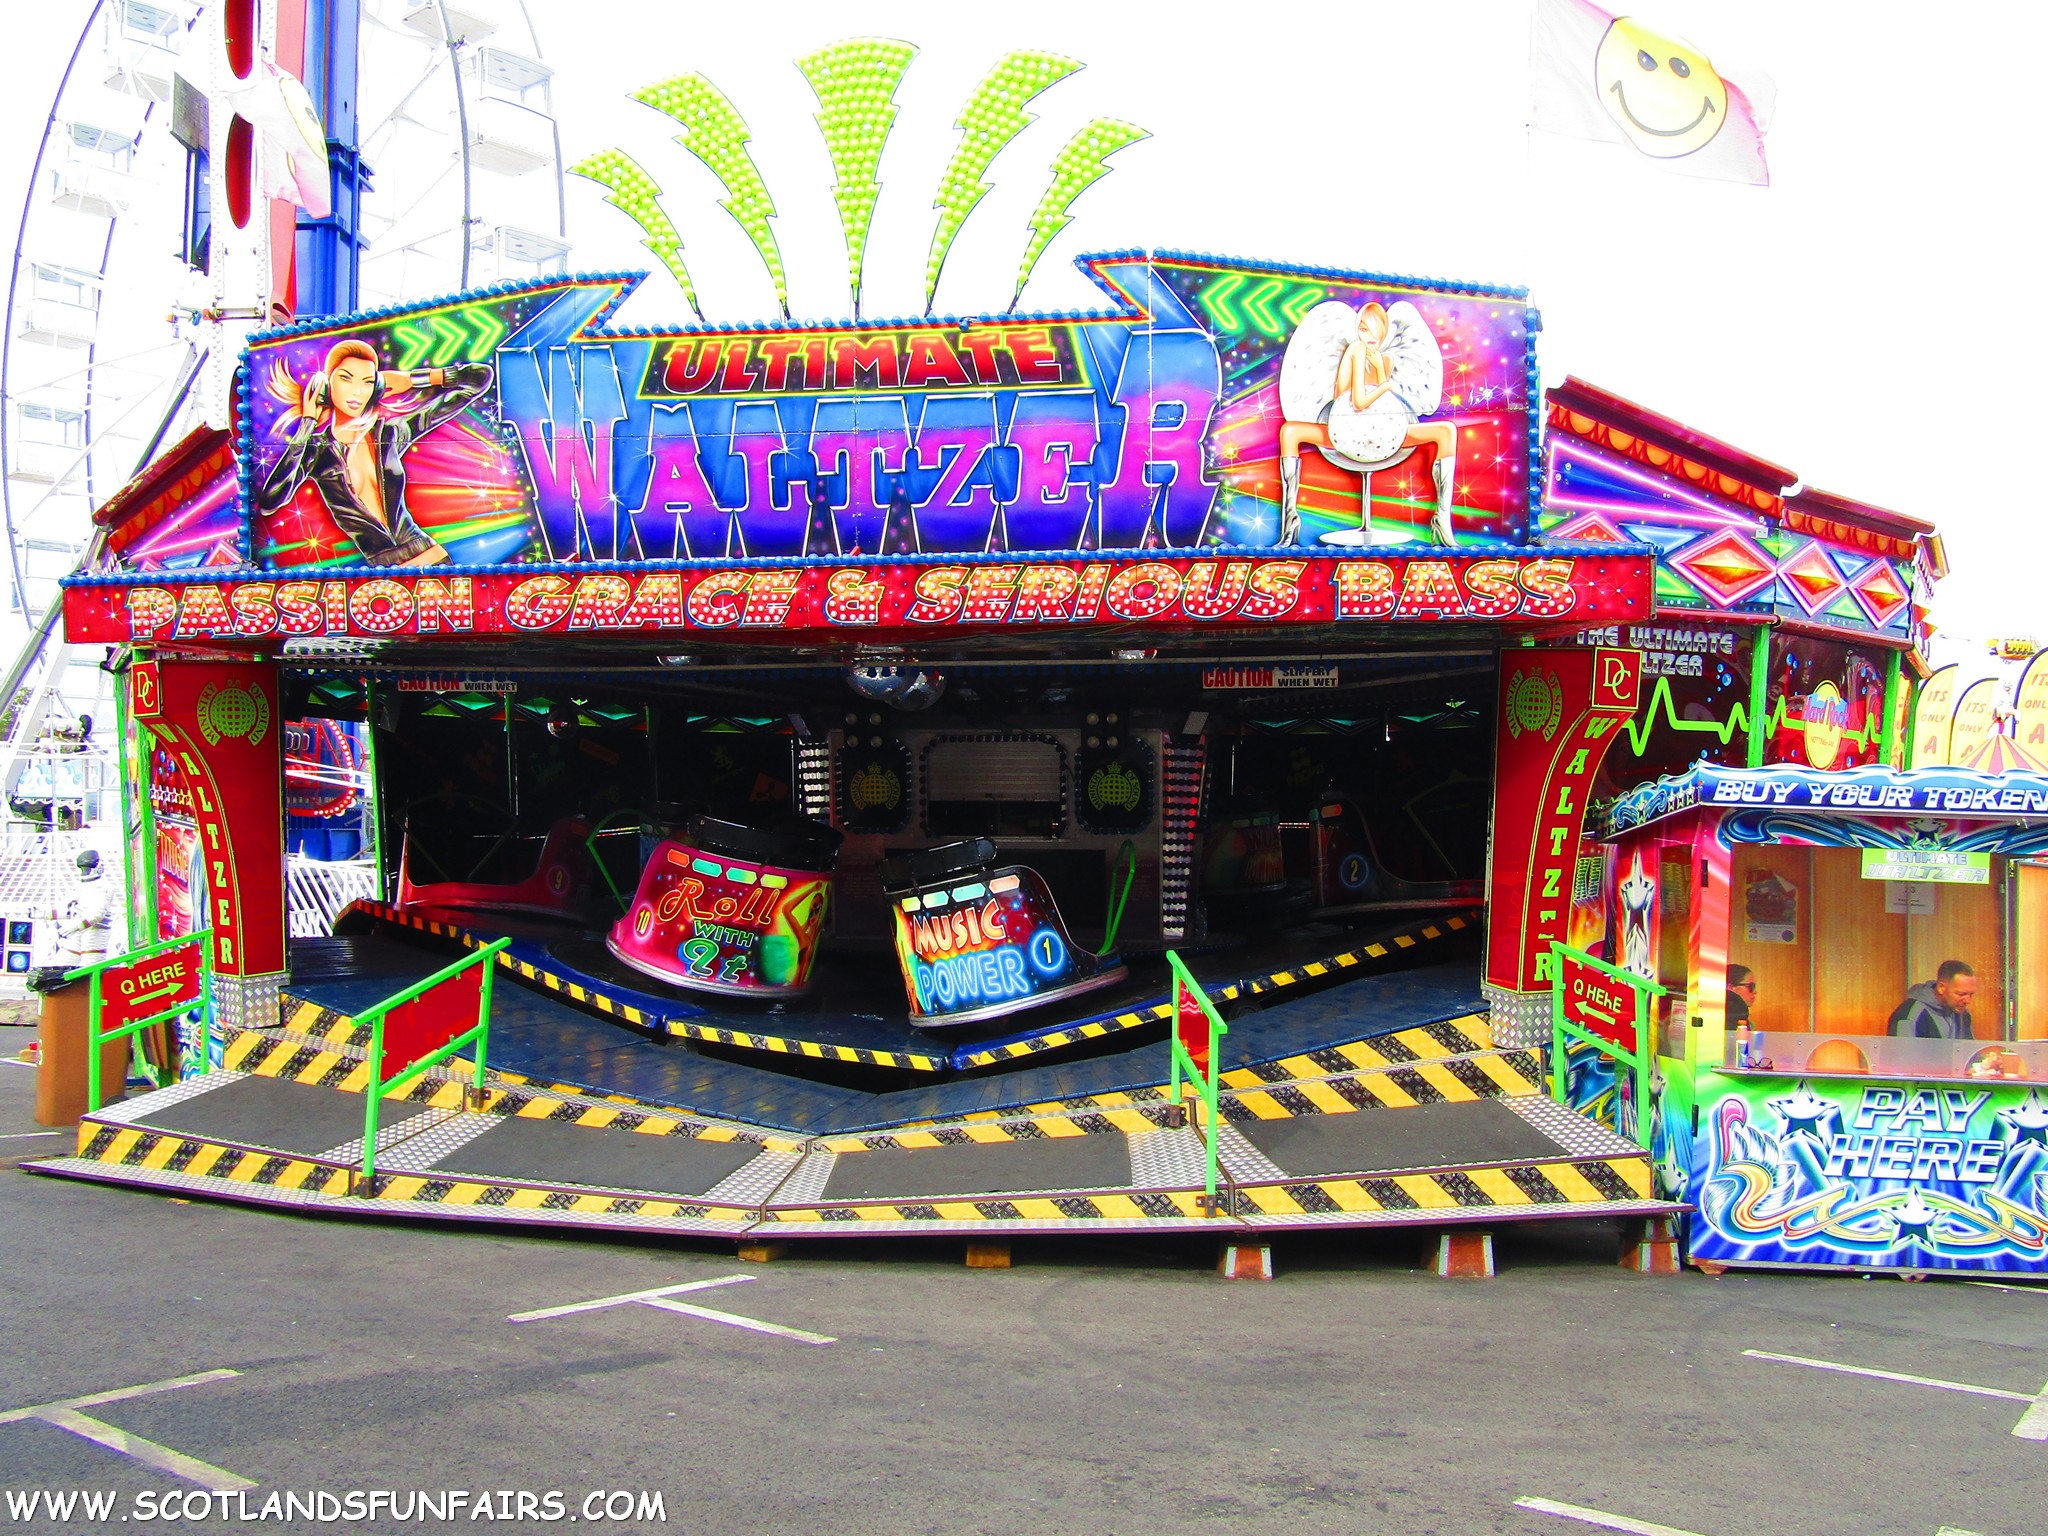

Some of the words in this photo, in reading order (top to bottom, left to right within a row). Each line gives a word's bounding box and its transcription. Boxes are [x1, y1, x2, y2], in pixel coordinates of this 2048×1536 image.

[664, 328, 1062, 394] ULTIMATE
[496, 332, 1223, 559] WALTZER
[125, 578, 474, 640] PASSION
[506, 570, 802, 632] GRACE
[829, 567, 884, 627] &
[905, 561, 1307, 625] SERIOUS
[1334, 559, 1578, 620] BASS
[1577, 626, 1619, 646] THE
[1629, 626, 1733, 655] ULTIMATE
[1203, 668, 1273, 687] CAUTION
[1602, 657, 1632, 700] DC
[1641, 652, 1703, 677] LTZER
[136, 671, 154, 708] DC
[464, 682, 492, 691] WHEN
[495, 682, 516, 691] WET
[1278, 677, 1310, 687] WHEN
[1313, 677, 1337, 687] WET
[2031, 674, 2048, 686] IT
[1506, 670, 1523, 738] MINISTRY
[1545, 695, 1563, 741] SOUND
[1927, 690, 1949, 702] ITS
[198, 682, 219, 745] MINISTRY
[251, 703, 269, 745] SOUND
[1920, 714, 1945, 723] ONLY
[1923, 735, 1938, 754] A
[1714, 780, 1799, 803] BUY
[1806, 783, 1913, 807] YOUR
[150, 723, 234, 965] WALTZER
[1886, 851, 1967, 865] ULTIMATE
[1865, 863, 1988, 882] WALTZER
[658, 877, 780, 925] Roll
[637, 909, 651, 935] 10
[693, 920, 755, 948] WITH
[913, 898, 1006, 955] MUSIC
[1043, 937, 1052, 964] 1
[120, 980, 135, 995] Q
[138, 962, 186, 989] HERE
[917, 949, 1029, 1010] POWER
[1573, 979, 1583, 996] Q
[1853, 1086, 1993, 1133] PAY
[1823, 1133, 2006, 1183] HERE
